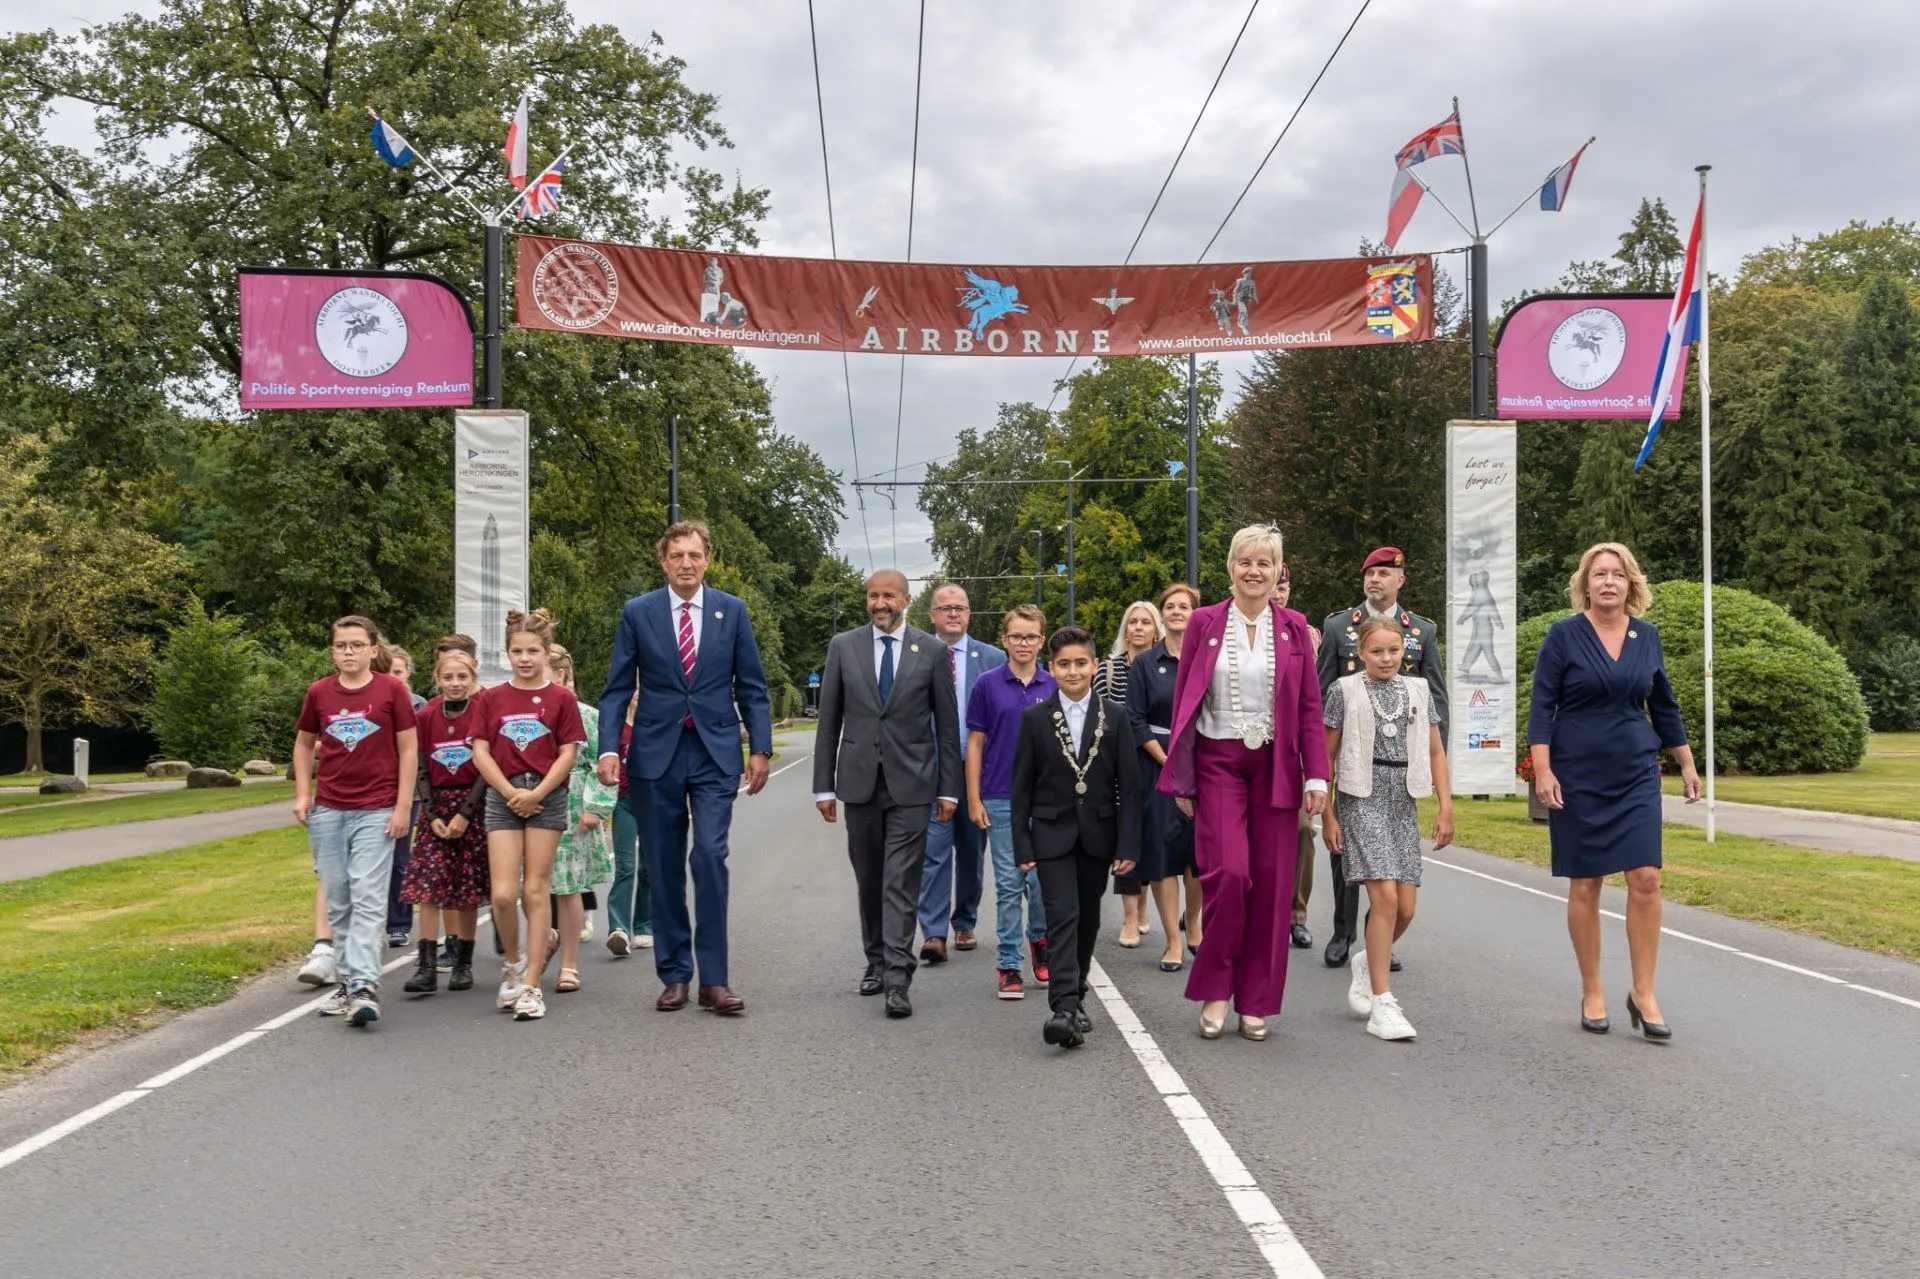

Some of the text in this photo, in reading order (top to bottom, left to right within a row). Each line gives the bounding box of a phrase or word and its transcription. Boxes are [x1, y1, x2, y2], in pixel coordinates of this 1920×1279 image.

[536, 247, 564, 282] AIRBORNE
[566, 246, 616, 283] WANDELTOCHT
[318, 289, 405, 328] AIRBORNE WANDELTOCHT
[620, 320, 820, 346] www.airborne-herdenkingen.nl
[860, 326, 1110, 353] AIRBORNE
[1138, 330, 1332, 349] www.airbornewandeltocht.nl
[333, 360, 393, 376] OOSTERBEEK
[251, 381, 470, 398] Politie Sportvereniging Renkum
[470, 462, 508, 470] AIRBORNE
[1465, 456, 1490, 469] Lest
[459, 469, 519, 477] HERDENKINGEN
[1464, 472, 1508, 490] forget!
